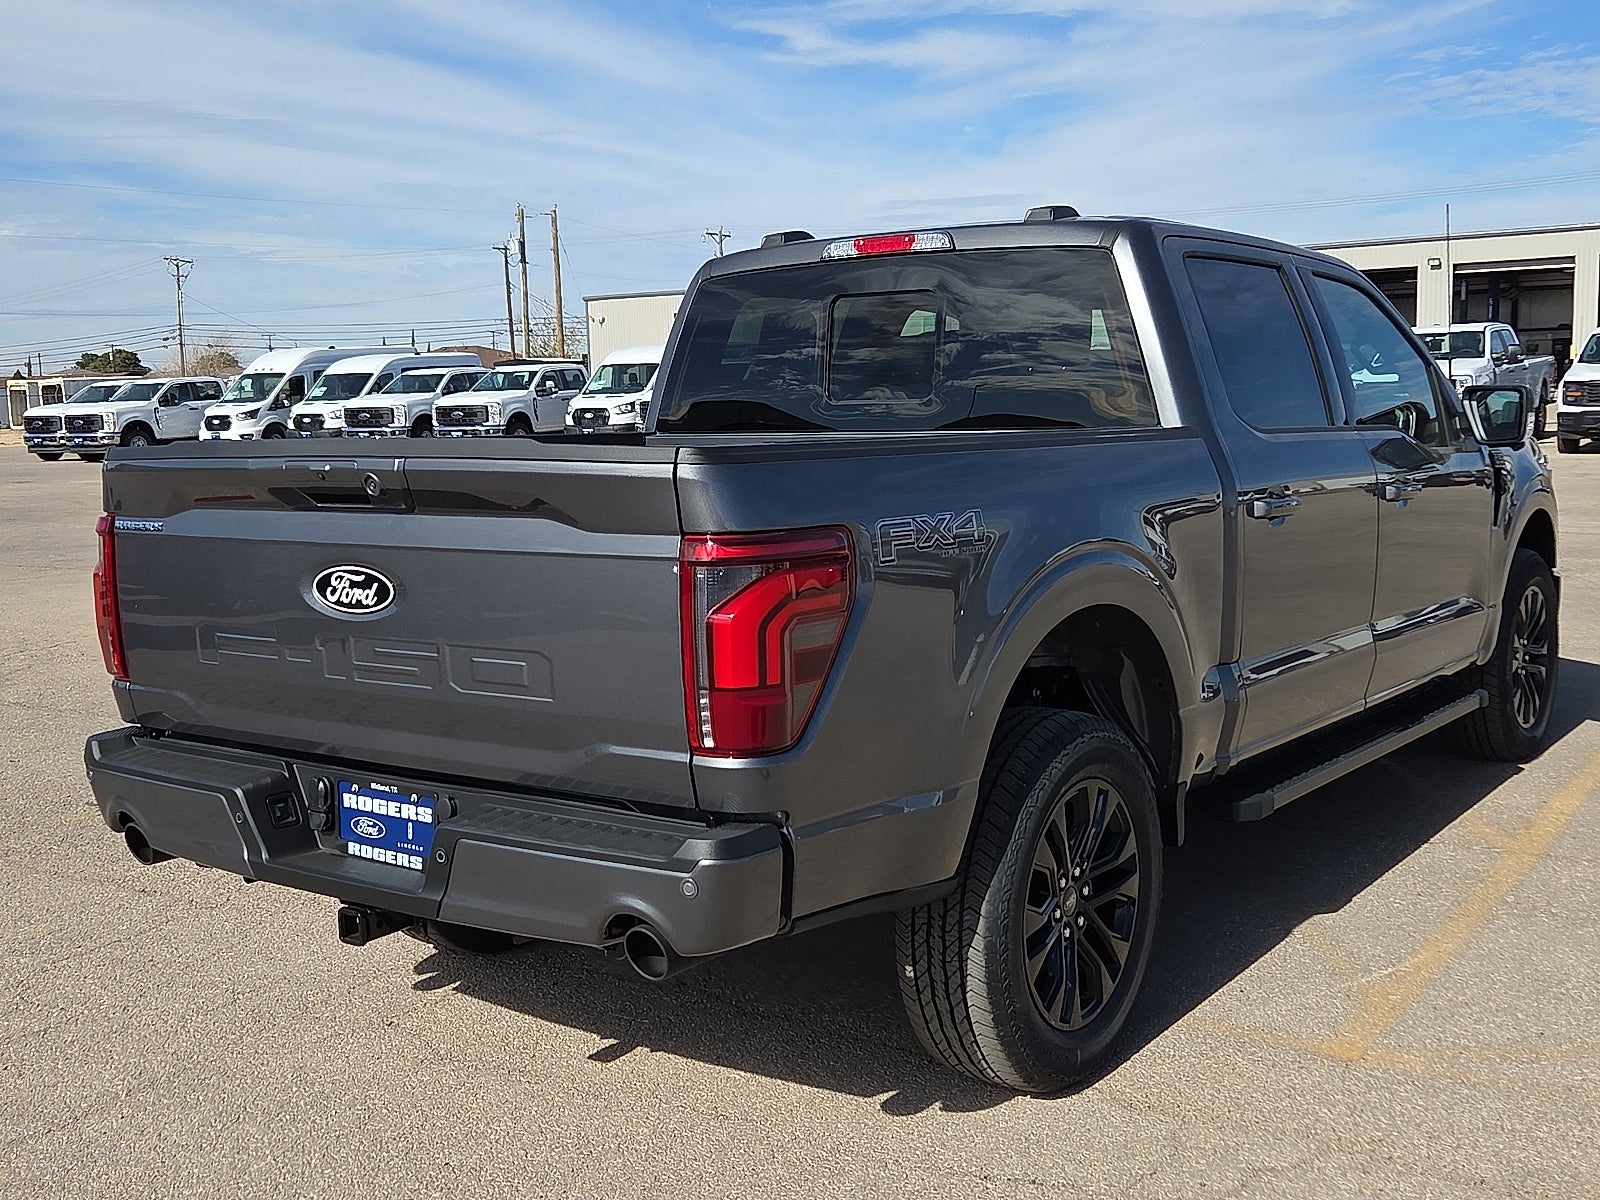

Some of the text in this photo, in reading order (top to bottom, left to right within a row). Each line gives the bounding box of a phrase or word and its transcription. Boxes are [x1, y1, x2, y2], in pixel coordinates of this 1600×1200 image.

[875, 509, 986, 567] FX4
[326, 571, 379, 607] Ford
[196, 622, 554, 702] F-150
[342, 792, 433, 823] ROGERS
[357, 818, 379, 836] Ford
[347, 841, 423, 870] ROGERS
